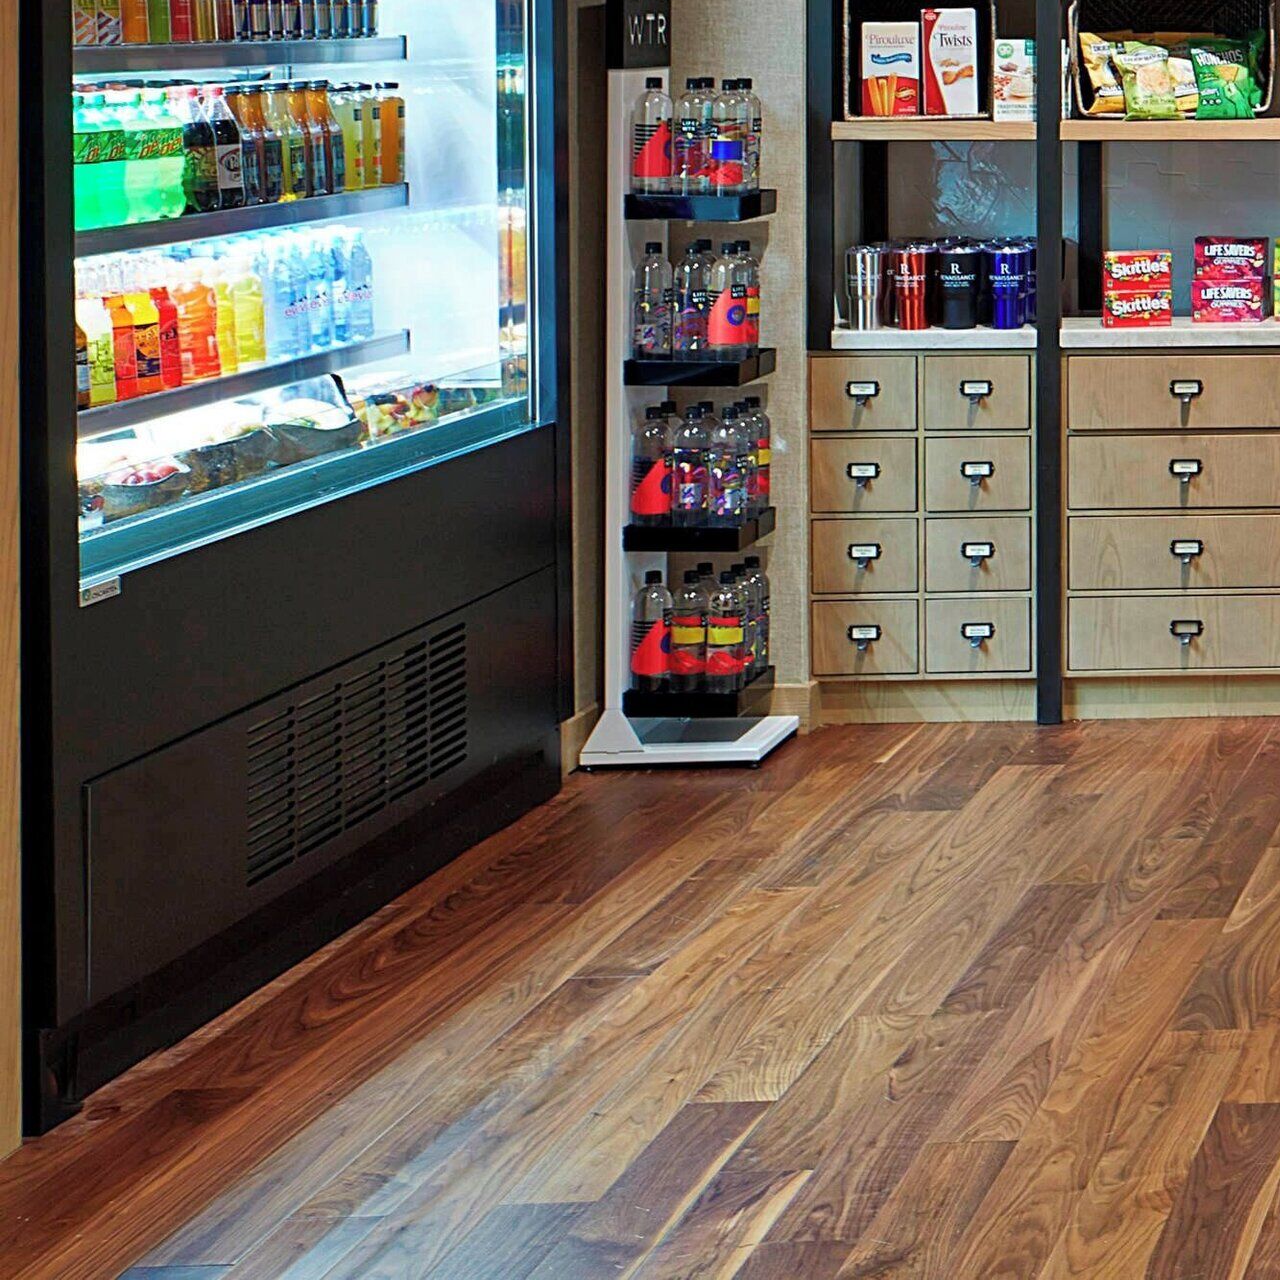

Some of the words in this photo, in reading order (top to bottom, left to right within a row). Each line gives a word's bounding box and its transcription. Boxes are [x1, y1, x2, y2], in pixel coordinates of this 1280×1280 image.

[628, 13, 667, 45] WTR
[933, 32, 973, 48] Twists
[1222, 244, 1256, 257] SAVERS
[1111, 260, 1169, 279] Skittles
[1220, 287, 1253, 300] SAVERS
[1112, 297, 1169, 316] Skittles
